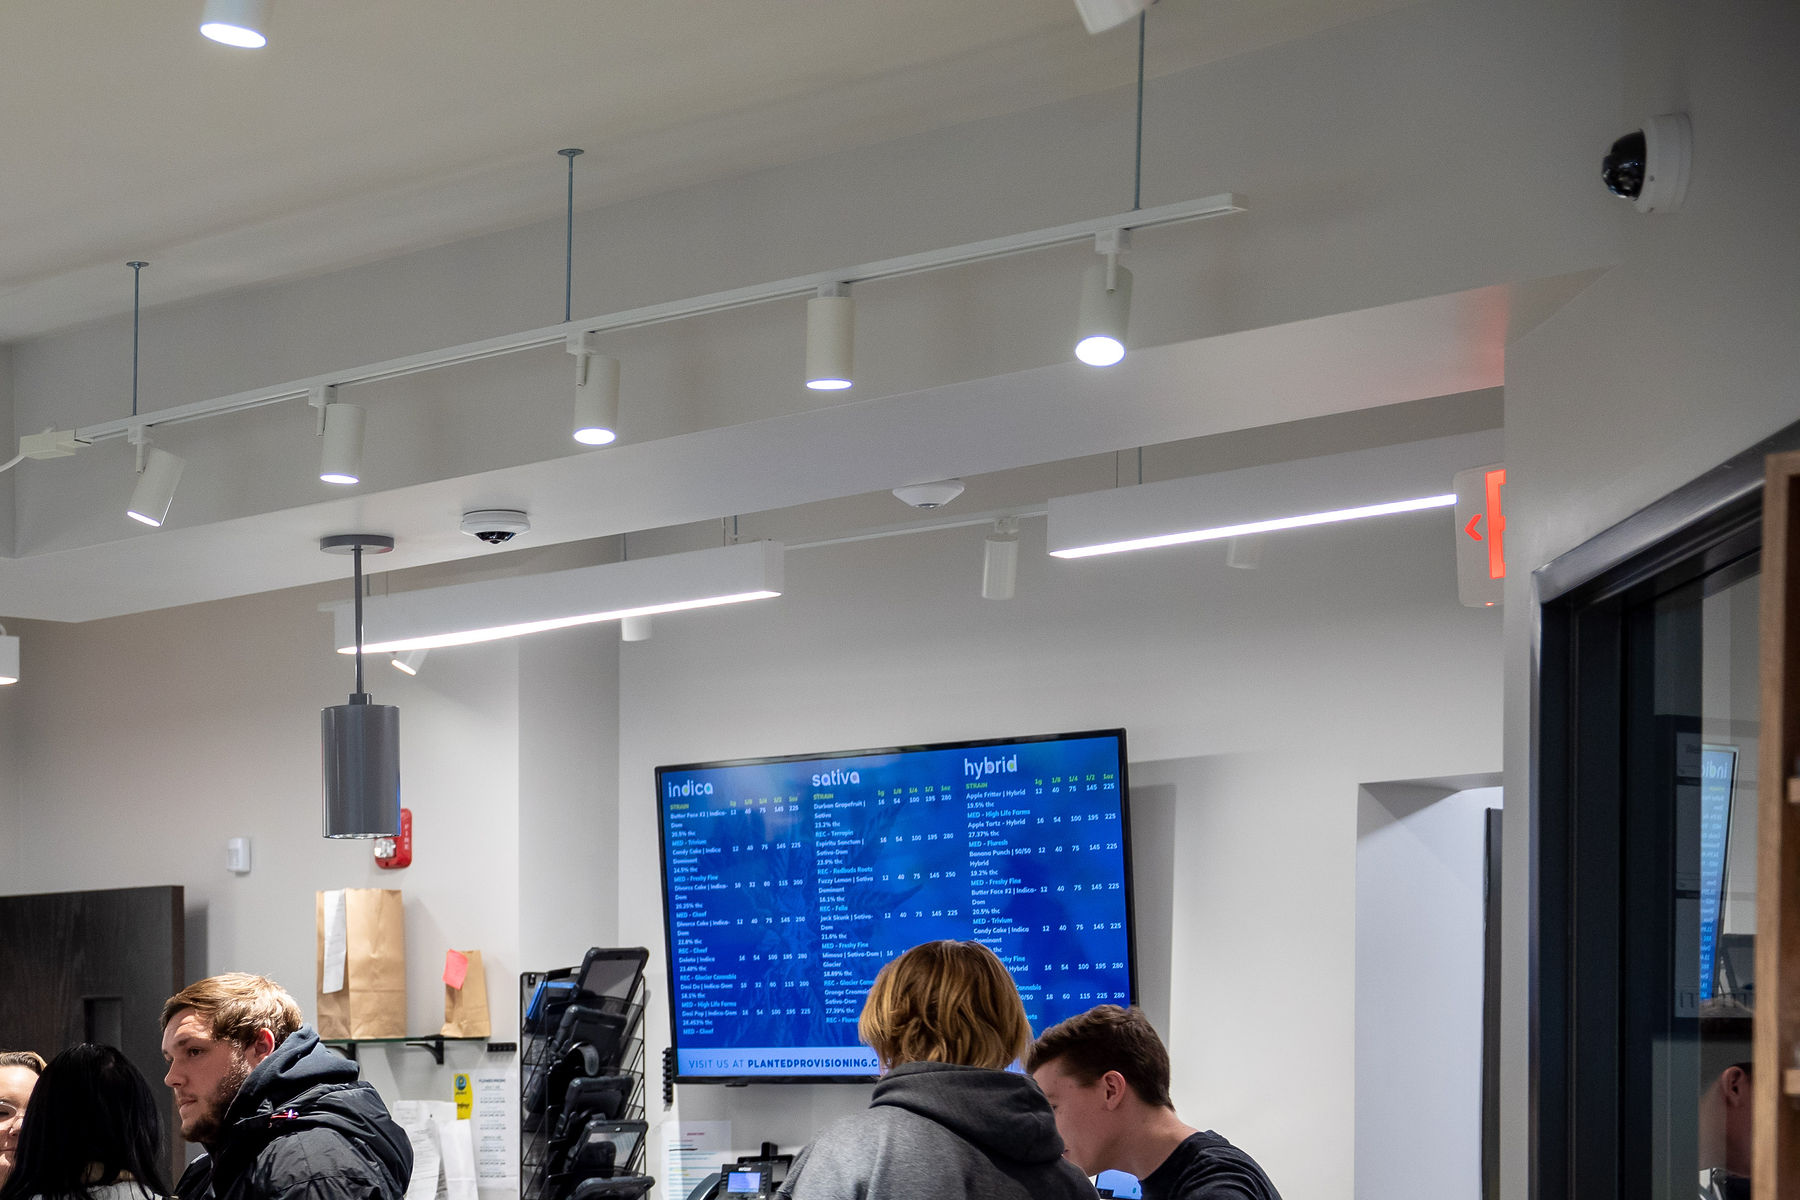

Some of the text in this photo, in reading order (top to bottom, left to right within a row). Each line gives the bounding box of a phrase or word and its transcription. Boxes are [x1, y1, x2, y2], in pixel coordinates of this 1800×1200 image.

[964, 754, 1017, 780] hybrid
[812, 769, 860, 787] sativa
[668, 780, 713, 798] indica
[1006, 789, 1025, 797] Hybrid
[1006, 818, 1025, 827] Hybrid
[689, 1058, 878, 1069] VISIT US AT PLANTEDPROVISIONING.C
